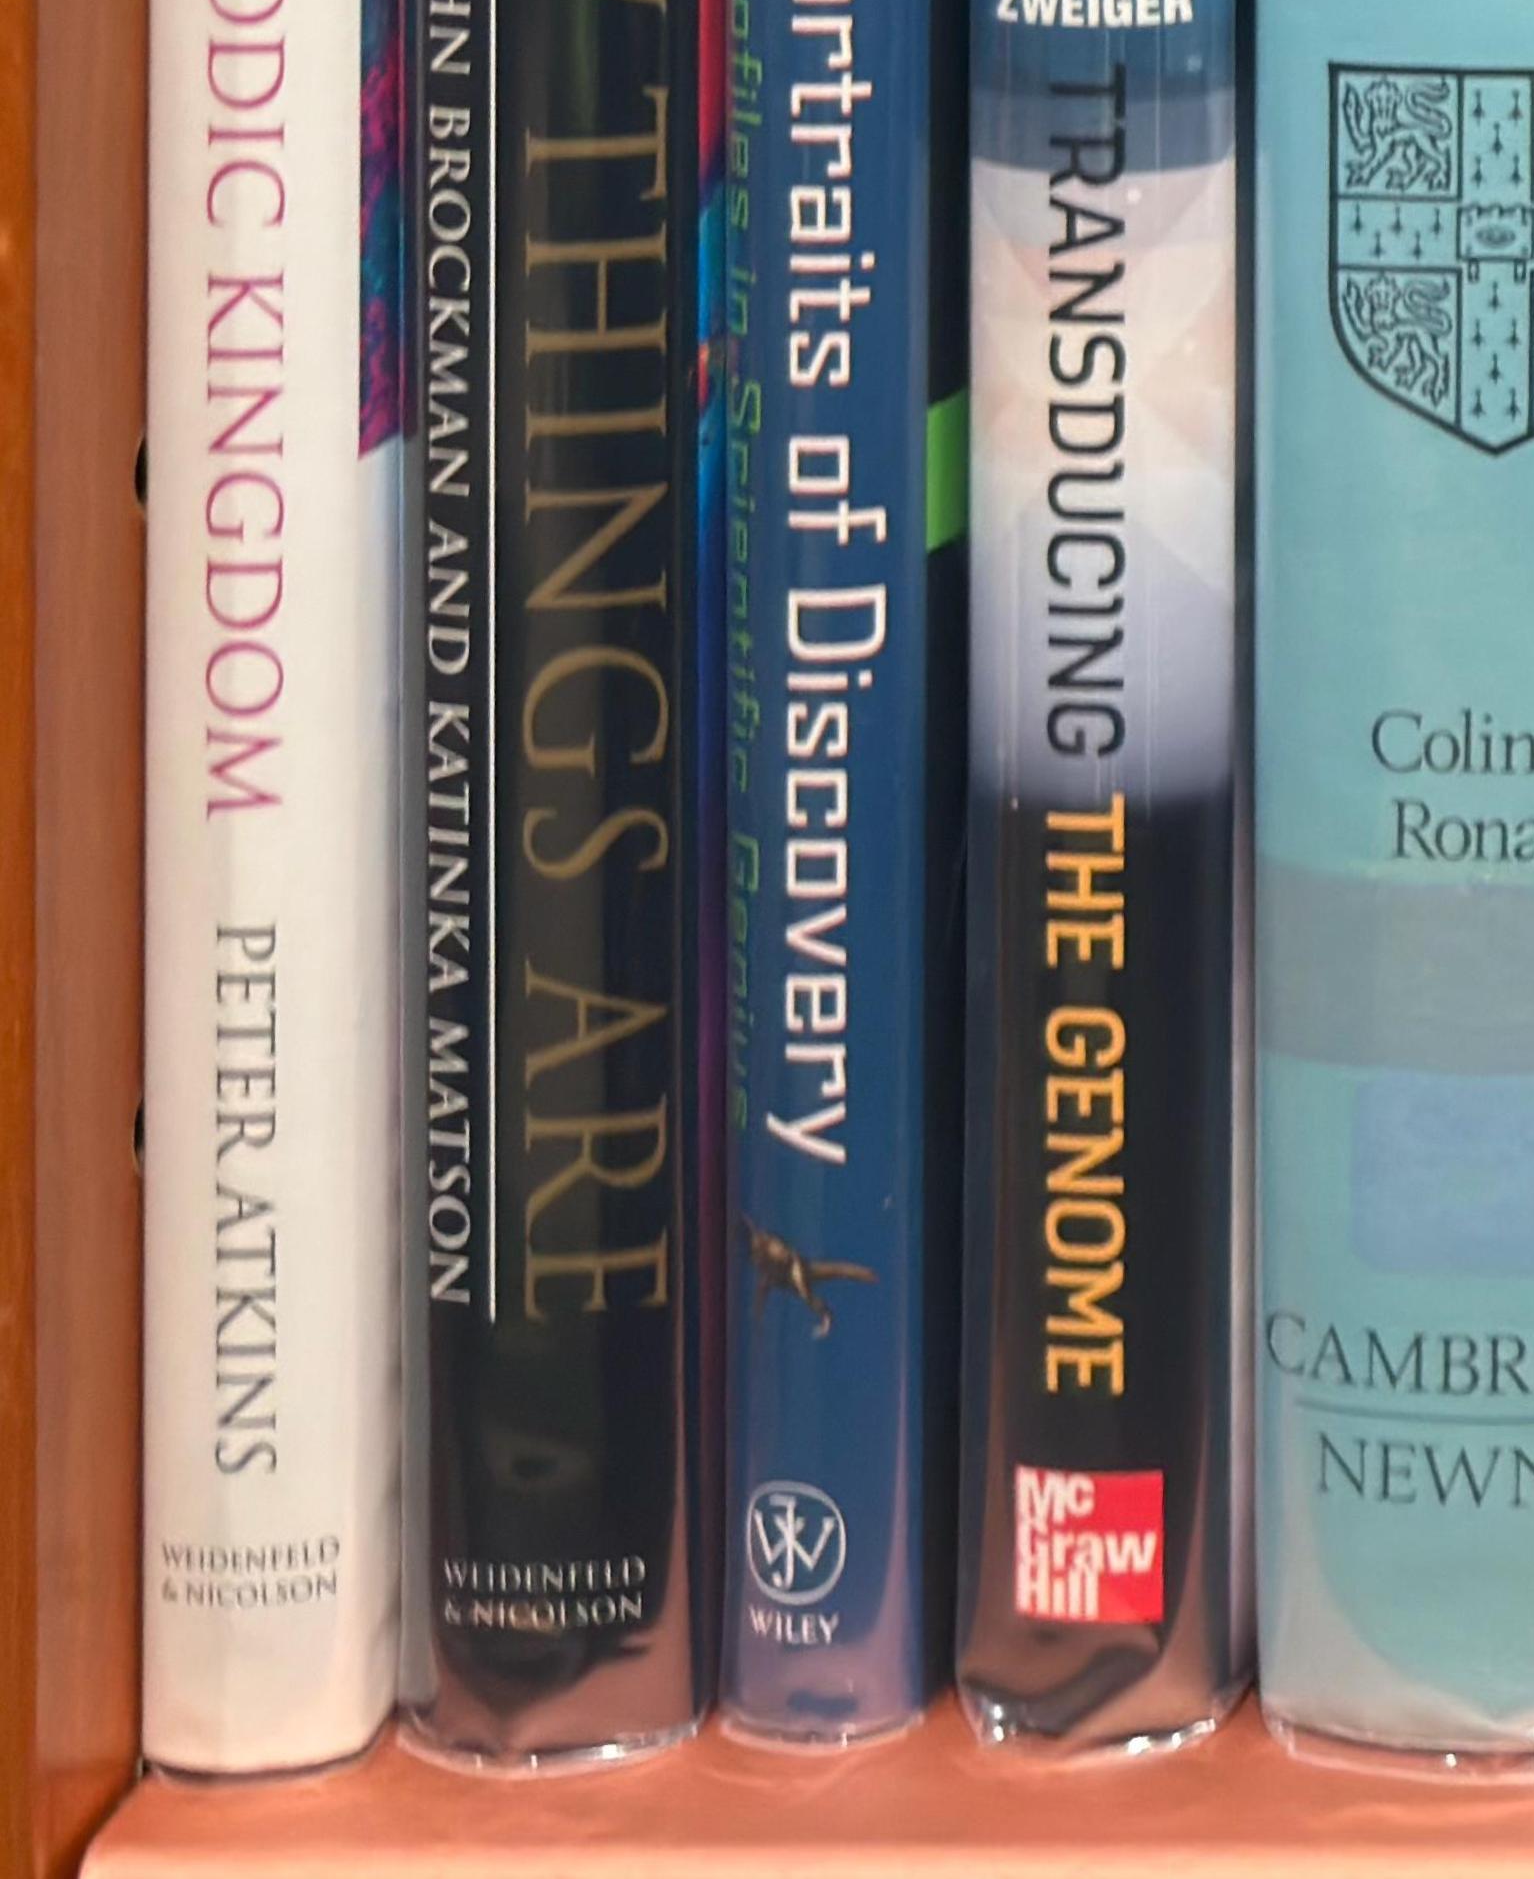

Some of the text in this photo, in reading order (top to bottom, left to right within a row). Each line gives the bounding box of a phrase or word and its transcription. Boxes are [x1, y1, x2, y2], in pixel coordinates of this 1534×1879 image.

[428, 106, 472, 497] BROCKMAN
[524, 84, 669, 880] THINGS
[788, 434, 888, 546] of
[205, 271, 284, 819] KINGDOM
[1044, 65, 1126, 1394] TRANSDUCING THE GENOME
[427, 703, 469, 998] KATINKA
[766, 589, 888, 1165] Discovery
[214, 922, 276, 1475] PETER ATKINS
[429, 1027, 471, 1307] MATSON
[524, 961, 669, 1318] ARE
[750, 1610, 838, 1644] WILEY
